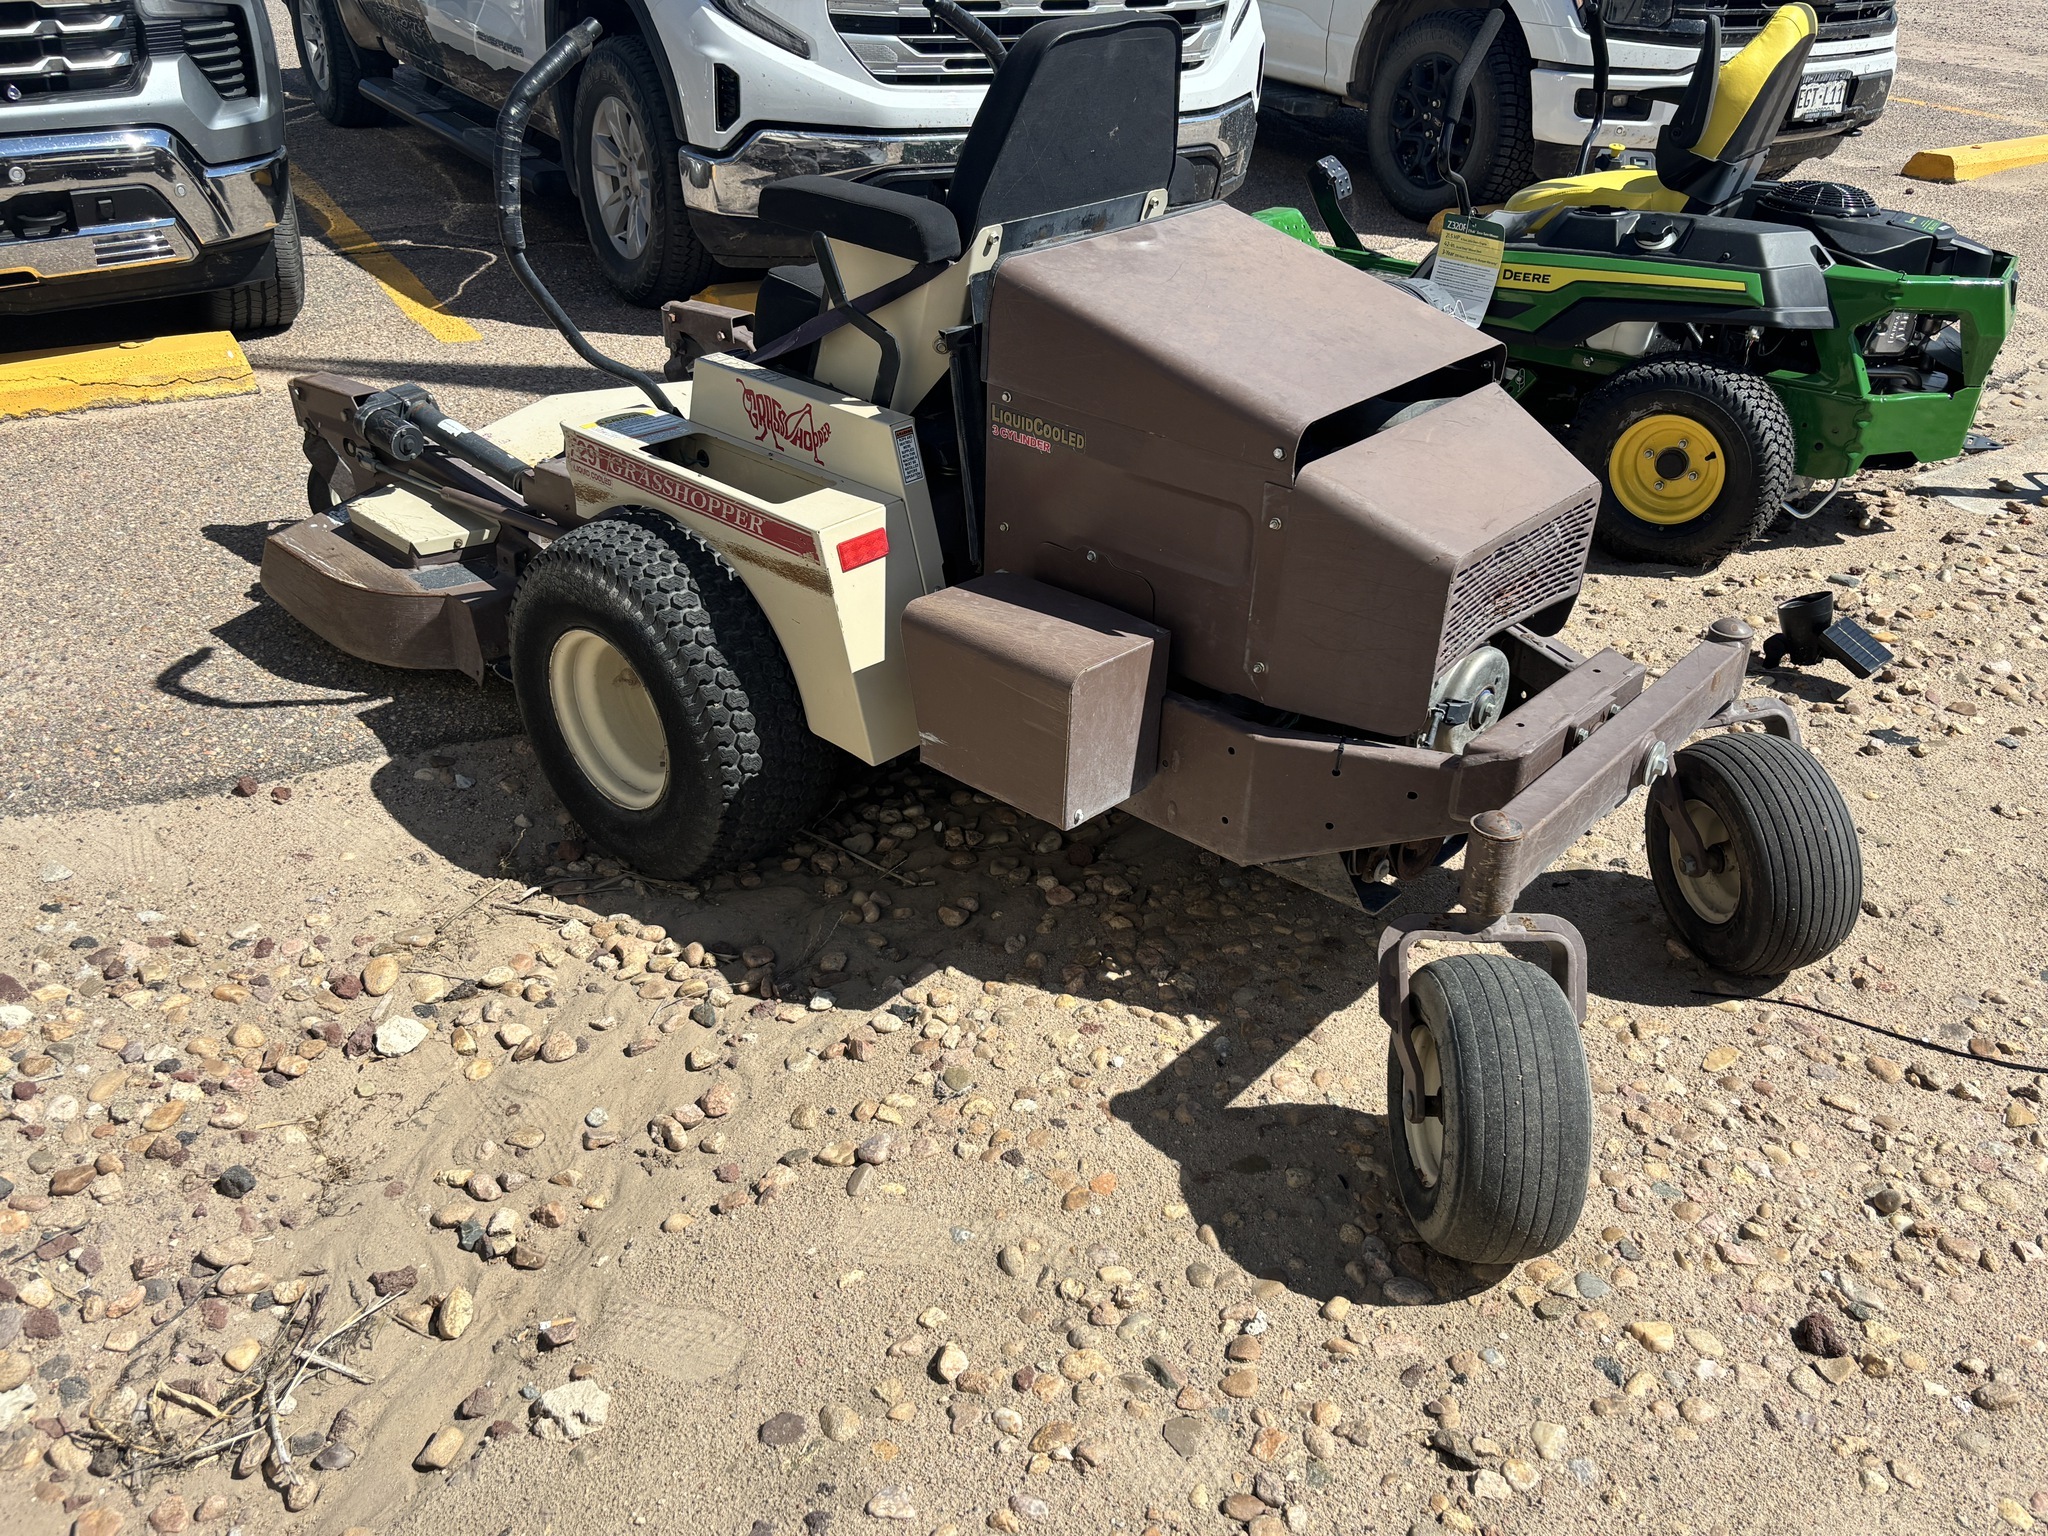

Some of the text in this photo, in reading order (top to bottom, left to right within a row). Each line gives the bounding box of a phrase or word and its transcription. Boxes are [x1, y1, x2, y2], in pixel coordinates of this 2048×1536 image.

[1502, 269, 1551, 284] DEERE
[991, 424, 1051, 453] 3 CYLINDER
[609, 453, 763, 535] GRASSHOPPER
